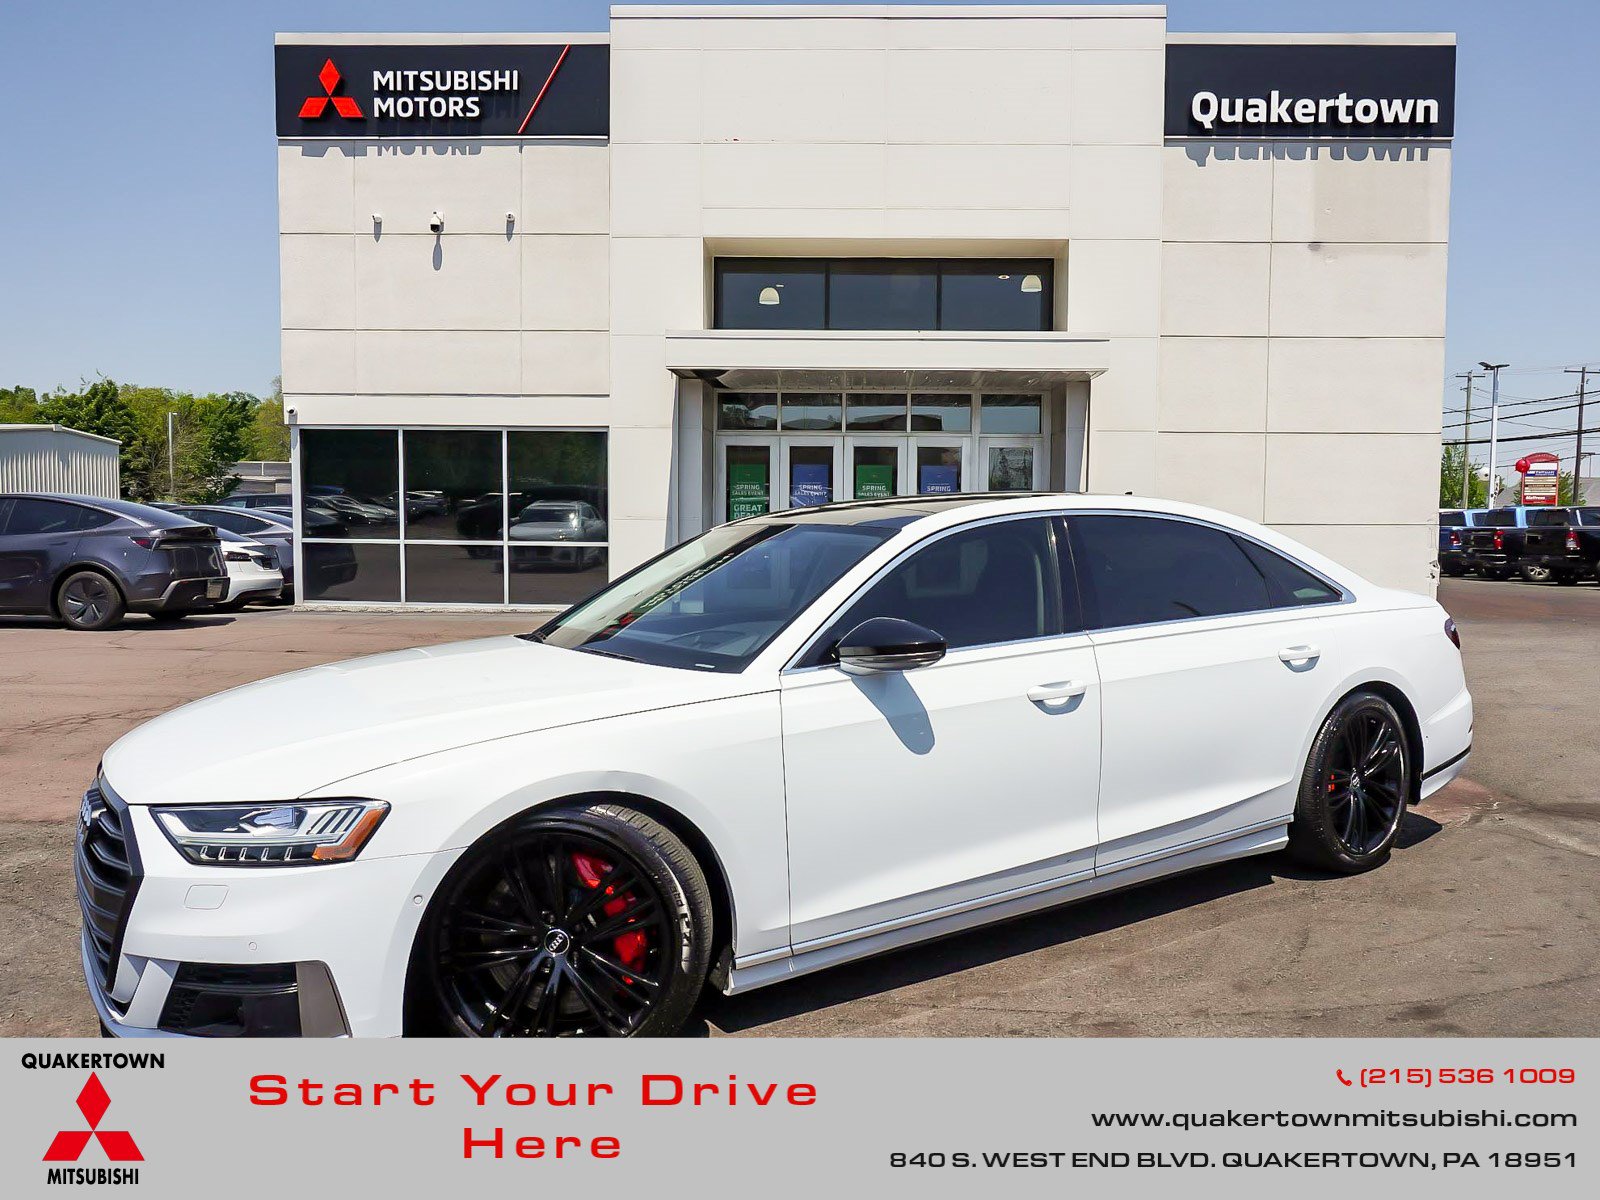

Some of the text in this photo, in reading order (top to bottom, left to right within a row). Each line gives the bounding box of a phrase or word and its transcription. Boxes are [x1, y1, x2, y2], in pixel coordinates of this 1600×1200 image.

[373, 70, 518, 91] MITSUBISHI
[373, 97, 480, 118] MOTORS
[1191, 90, 1439, 128] Quakertown
[733, 504, 763, 512] GREAT
